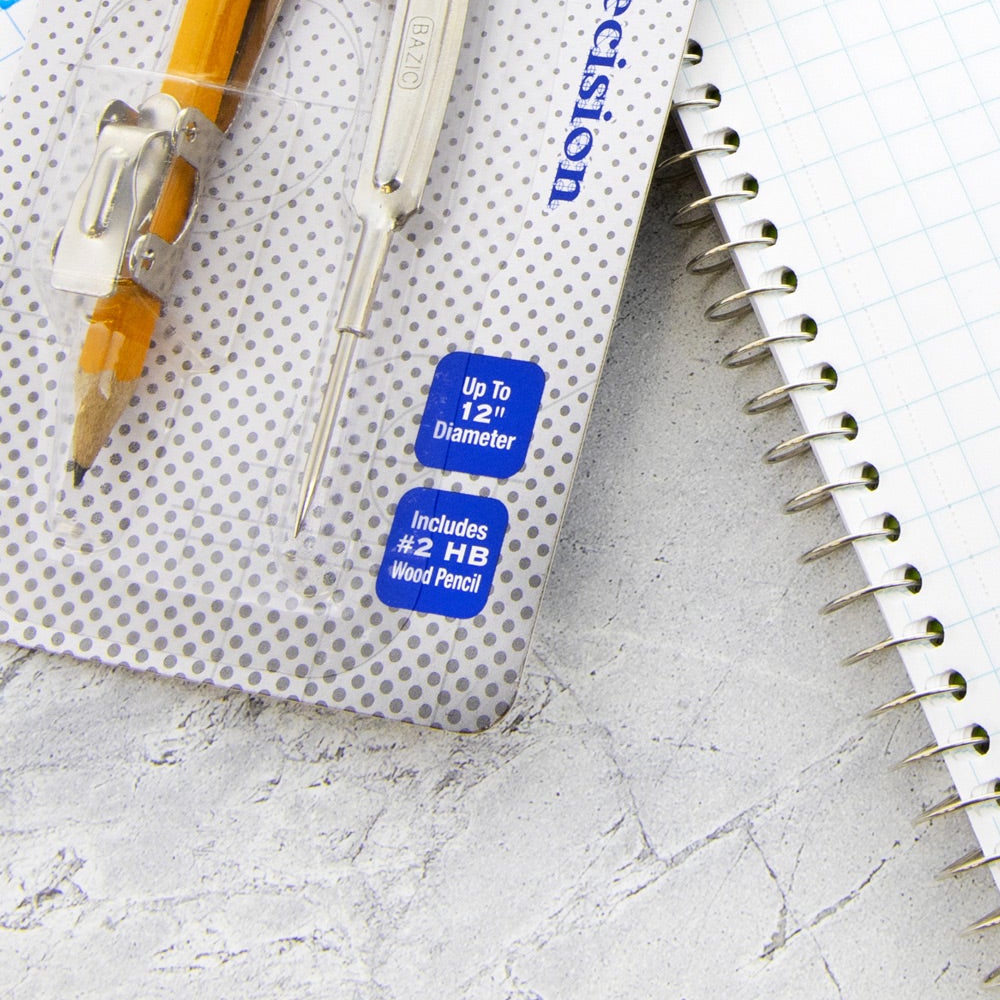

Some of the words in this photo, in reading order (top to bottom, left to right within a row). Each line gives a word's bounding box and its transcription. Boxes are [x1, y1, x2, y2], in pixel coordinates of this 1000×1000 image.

[401, 23, 430, 84] BAZIC
[462, 376, 487, 400] Up
[492, 380, 511, 401] To
[461, 401, 505, 424] 12"
[433, 420, 517, 451] Diameter
[411, 510, 489, 541] Includes
[396, 534, 434, 558] #2
[444, 541, 490, 567] HB
[391, 560, 432, 585] Wood
[435, 567, 482, 594] Pencil
